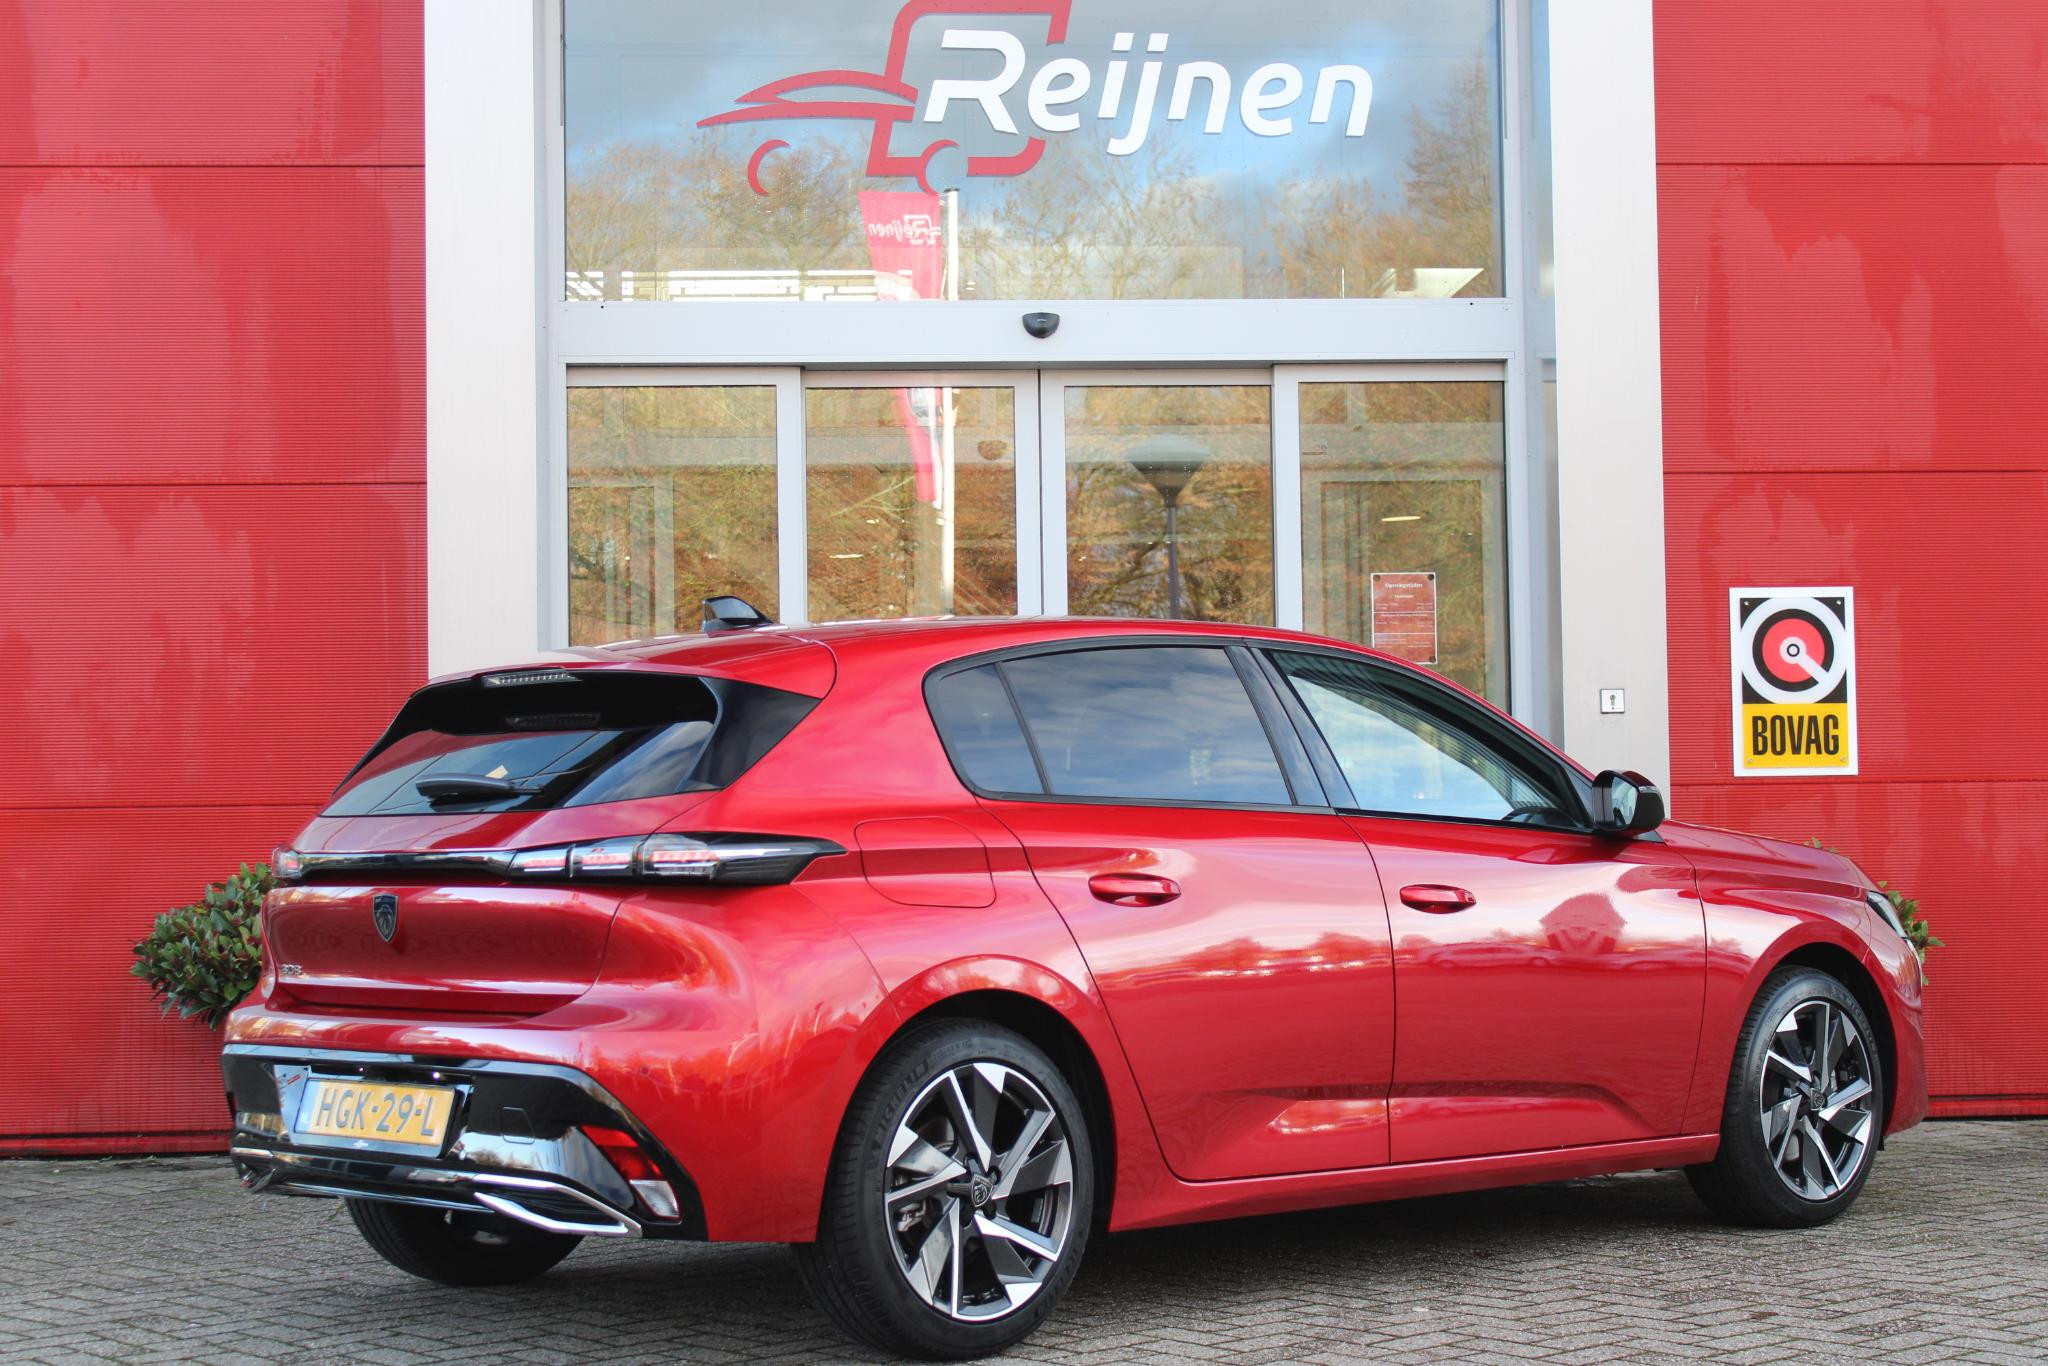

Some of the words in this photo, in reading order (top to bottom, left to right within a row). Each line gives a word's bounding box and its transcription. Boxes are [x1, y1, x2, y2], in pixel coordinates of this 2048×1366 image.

[924, 29, 1373, 156] Reijnen
[1751, 714, 1839, 756] BOVAG
[316, 1087, 435, 1137] HGK-29-L
